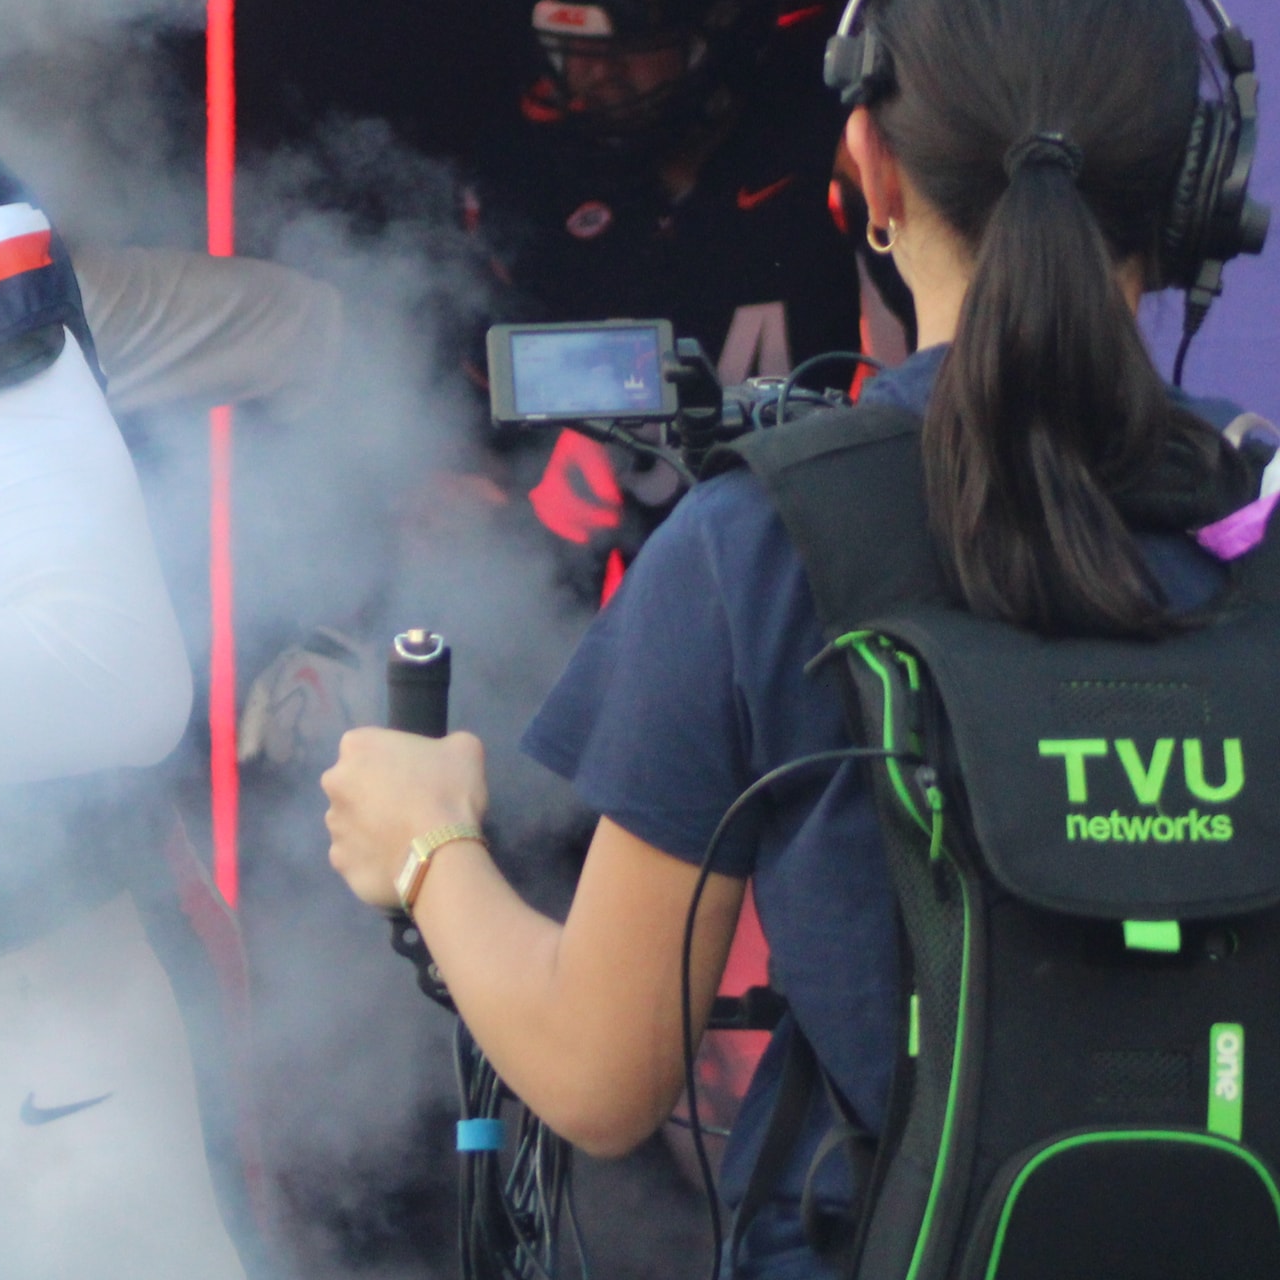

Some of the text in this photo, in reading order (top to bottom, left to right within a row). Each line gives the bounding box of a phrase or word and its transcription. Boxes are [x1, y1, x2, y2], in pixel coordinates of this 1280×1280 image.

[1038, 737, 1246, 805] TVU
[1065, 807, 1235, 844] networks
[1215, 1031, 1240, 1102] one
